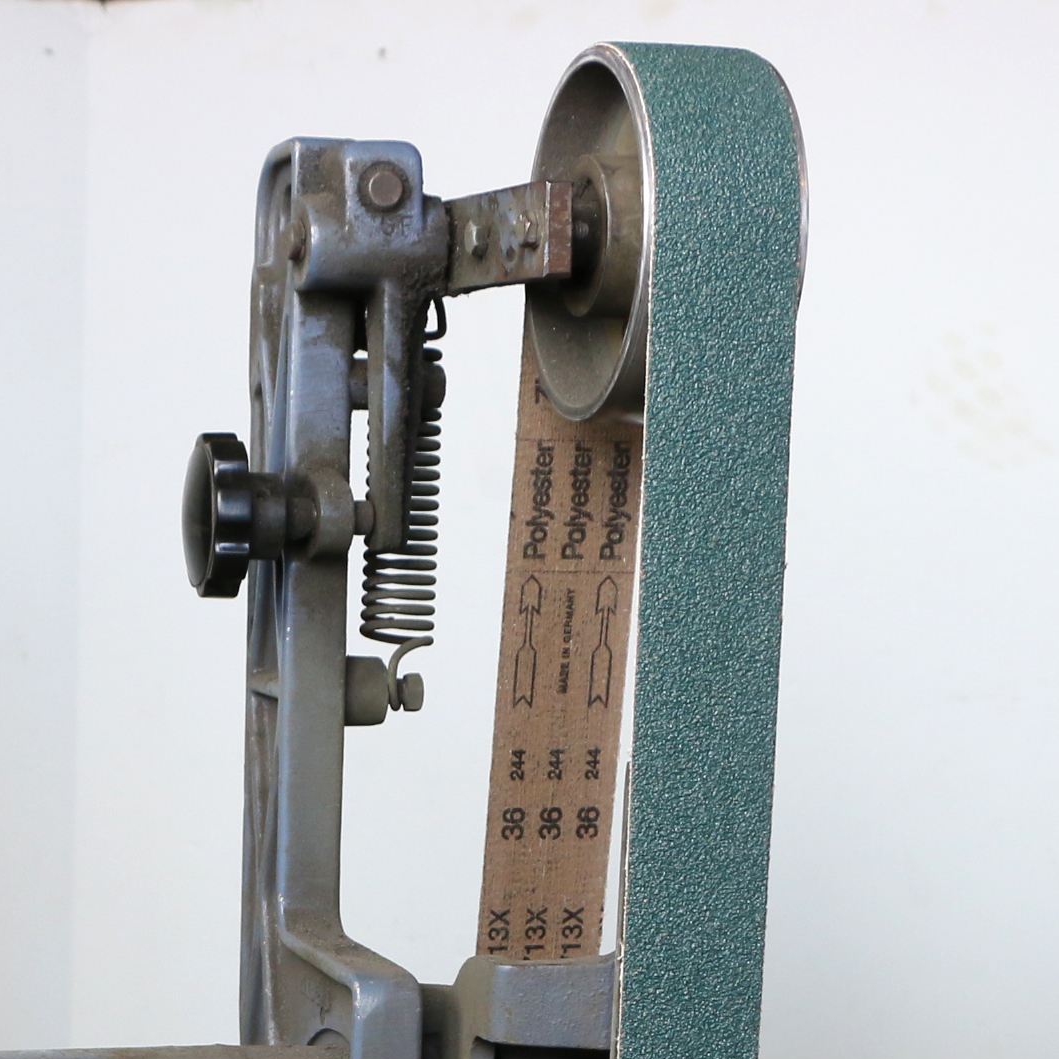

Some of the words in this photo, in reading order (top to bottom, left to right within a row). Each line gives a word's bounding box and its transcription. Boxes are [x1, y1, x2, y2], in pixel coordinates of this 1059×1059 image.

[523, 440, 555, 559] Polyester
[561, 440, 594, 560] Polyester
[599, 441, 632, 560] Polyester
[563, 588, 575, 643] GERMANY
[561, 647, 571, 659] IN
[556, 661, 570, 694] MADE
[509, 749, 527, 781] 244
[547, 748, 564, 781] 244
[584, 748, 602, 781] 244
[501, 806, 526, 841] 36
[538, 806, 563, 841] 36
[575, 805, 601, 840] 36
